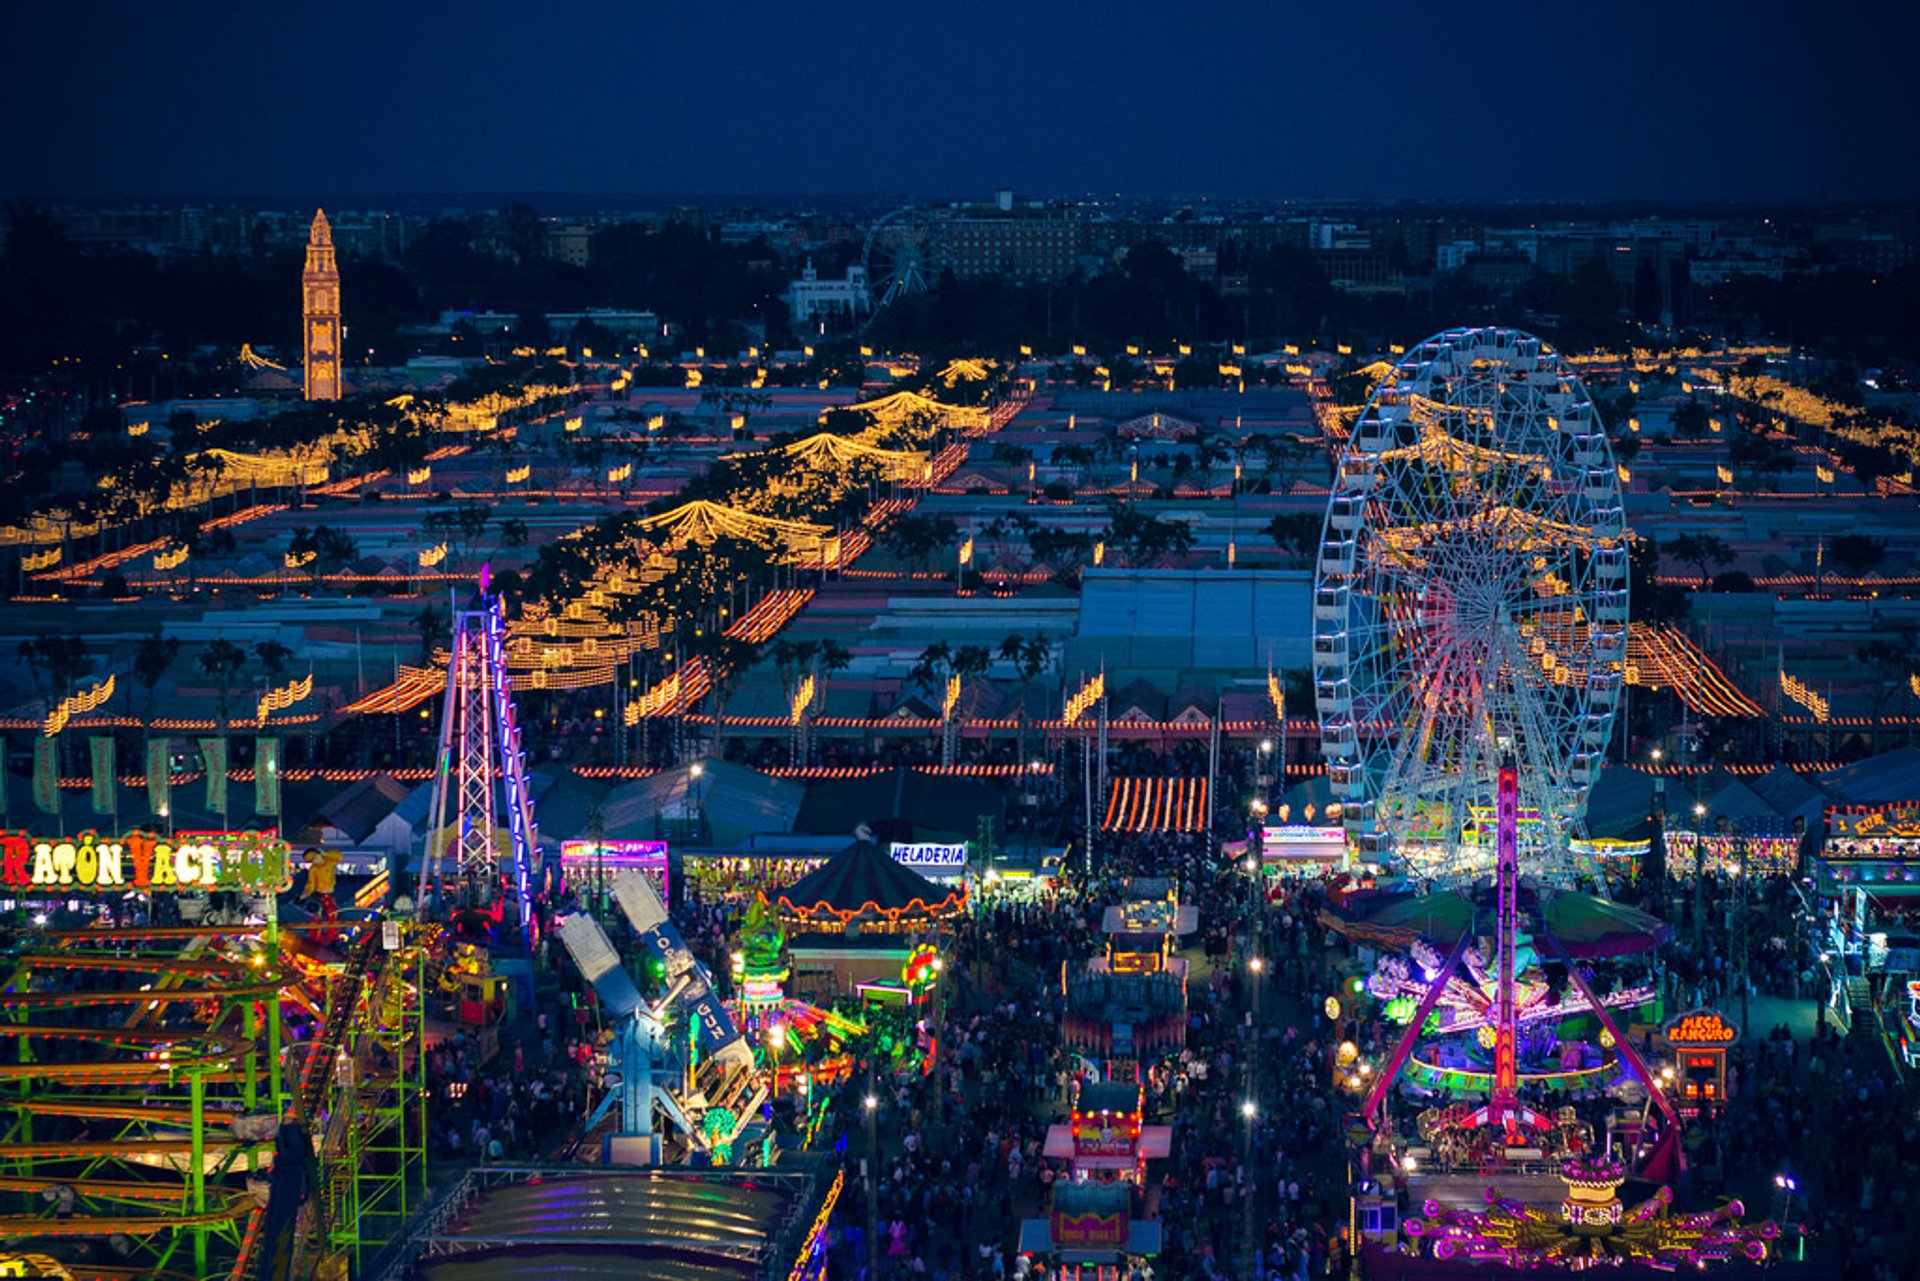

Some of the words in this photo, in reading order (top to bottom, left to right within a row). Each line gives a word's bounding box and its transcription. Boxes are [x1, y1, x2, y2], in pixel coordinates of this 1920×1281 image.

[0, 835, 124, 885] RATÓN
[893, 846, 963, 864] HELADERIA
[649, 923, 675, 960] TOP
[697, 1003, 725, 1040] GUN
[1681, 1015, 1722, 1029] MEGA
[1668, 1027, 1734, 1041] KANGURO
